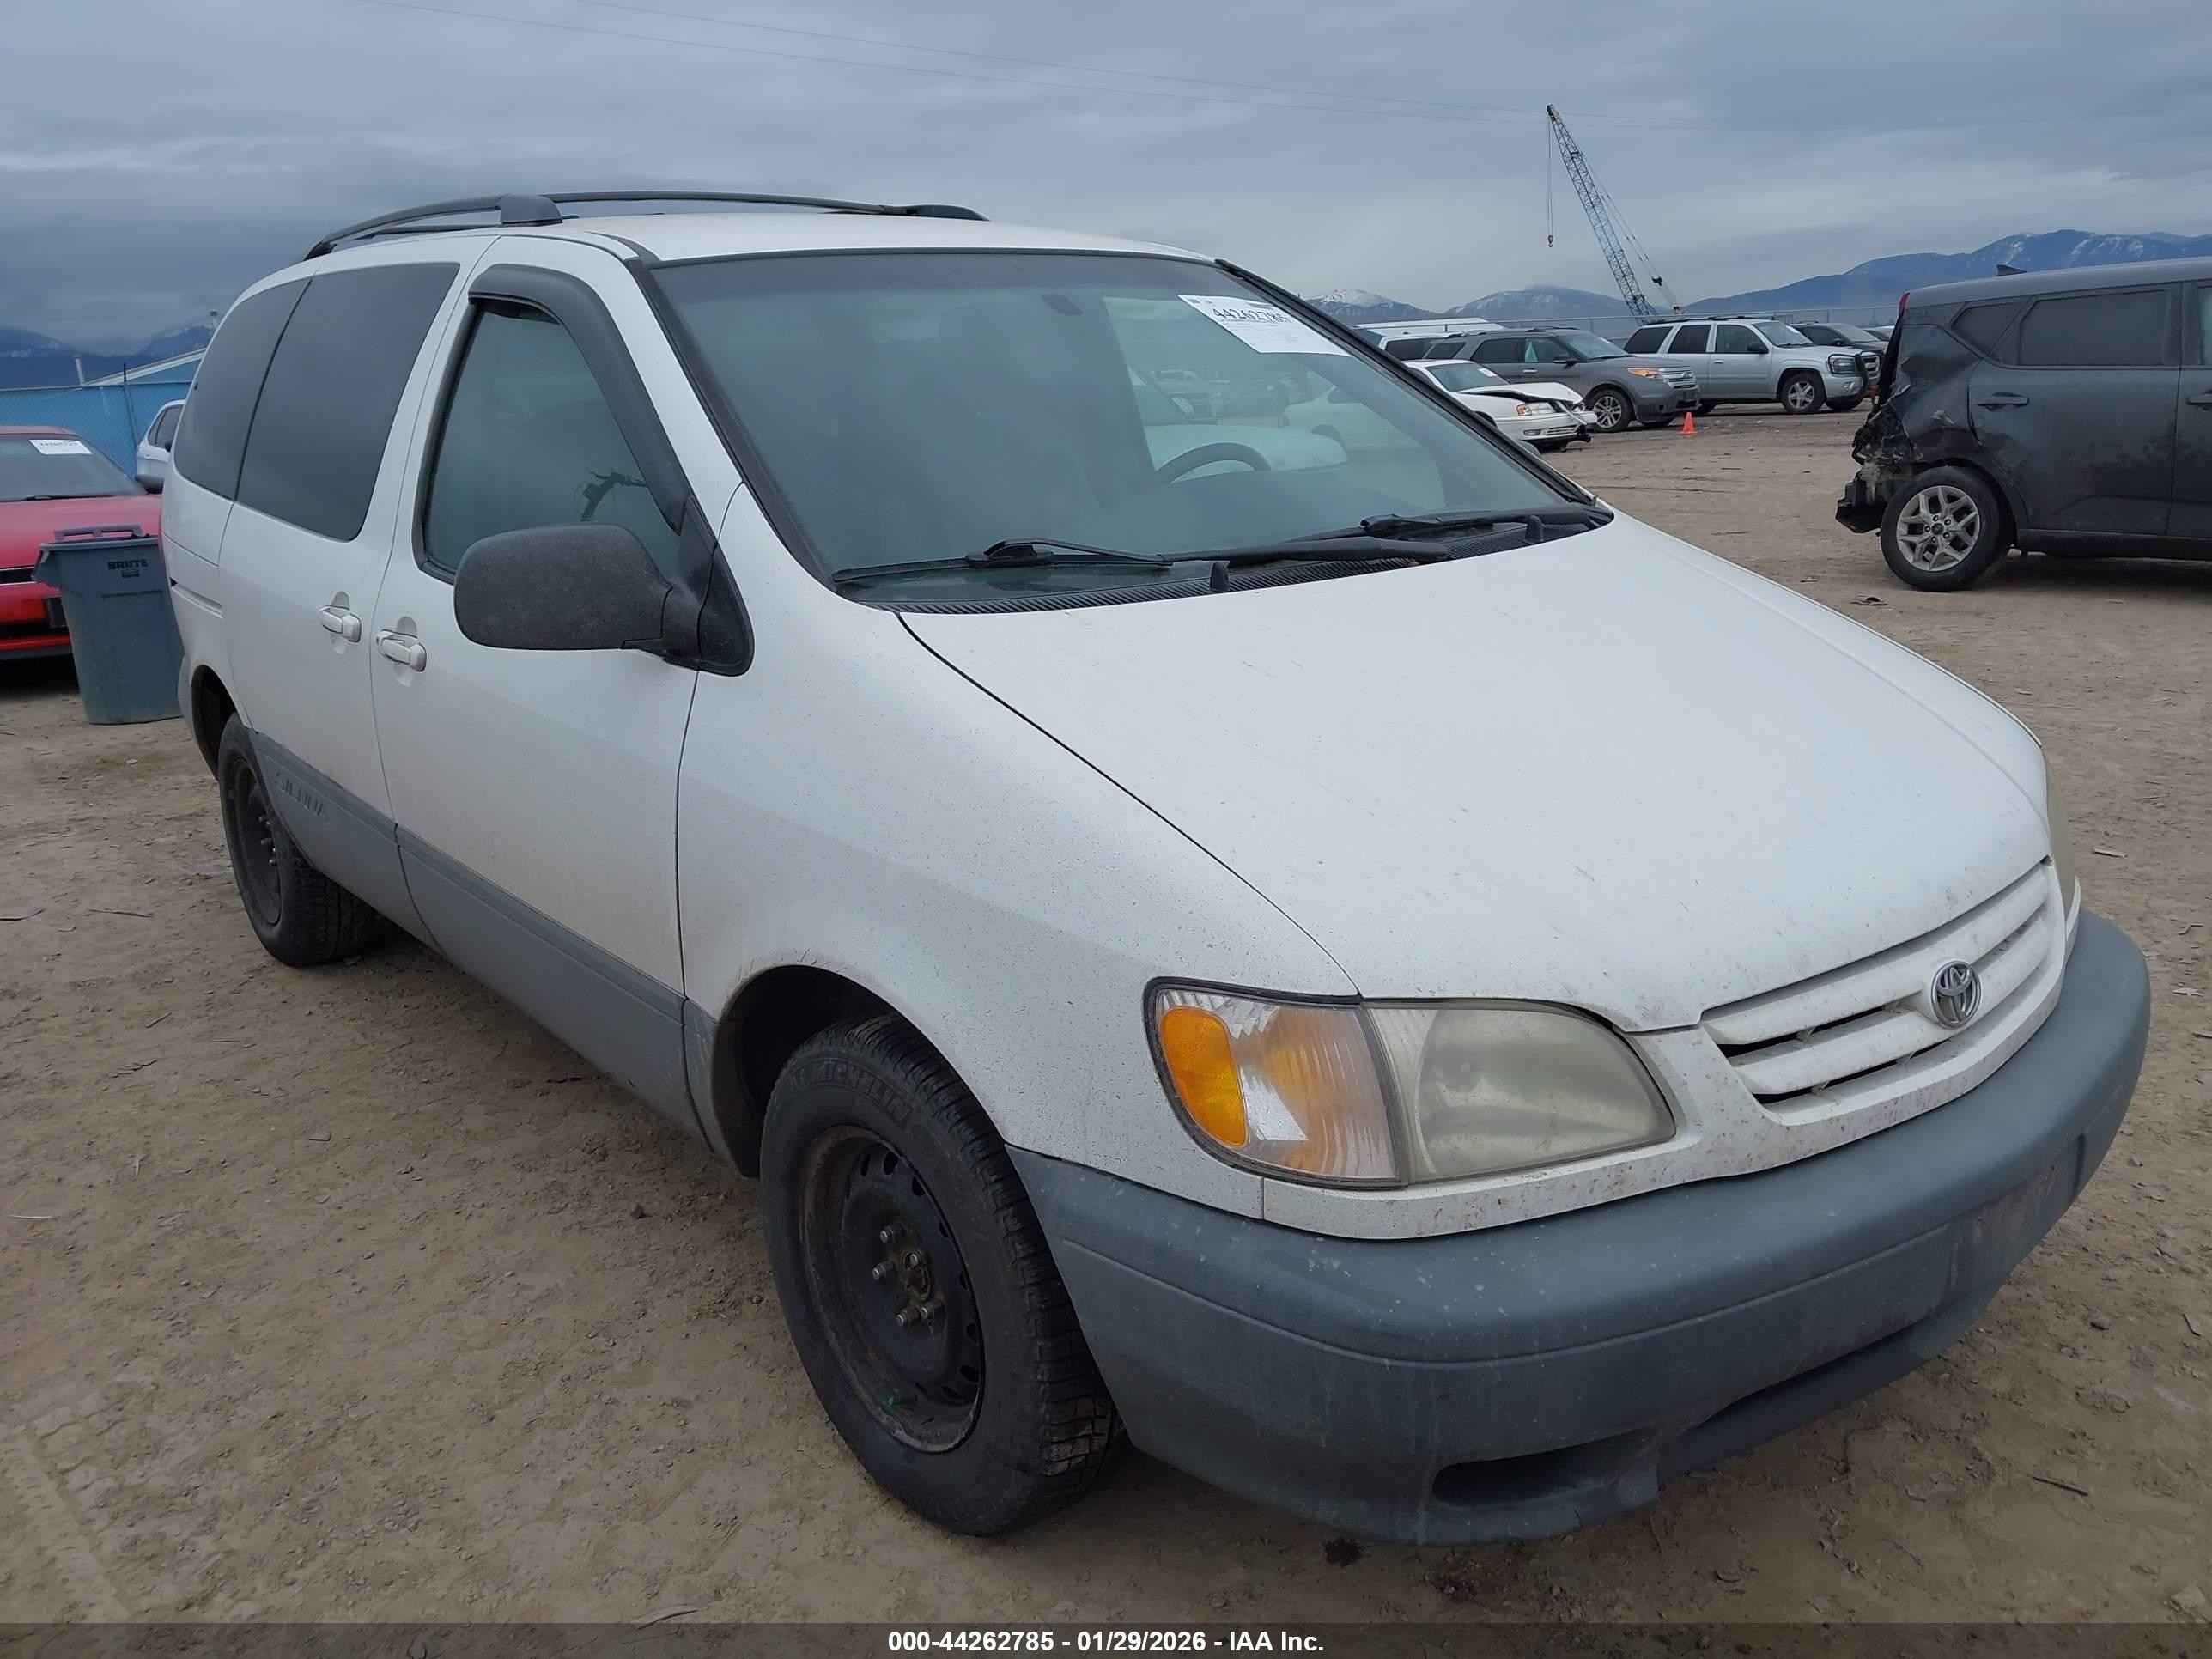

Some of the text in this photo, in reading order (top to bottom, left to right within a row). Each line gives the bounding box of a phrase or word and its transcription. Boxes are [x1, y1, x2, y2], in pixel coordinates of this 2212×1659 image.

[1212, 308, 1292, 323] 44262785
[107, 558, 149, 570] BRUTE
[811, 1061, 914, 1127] MICHELIN
